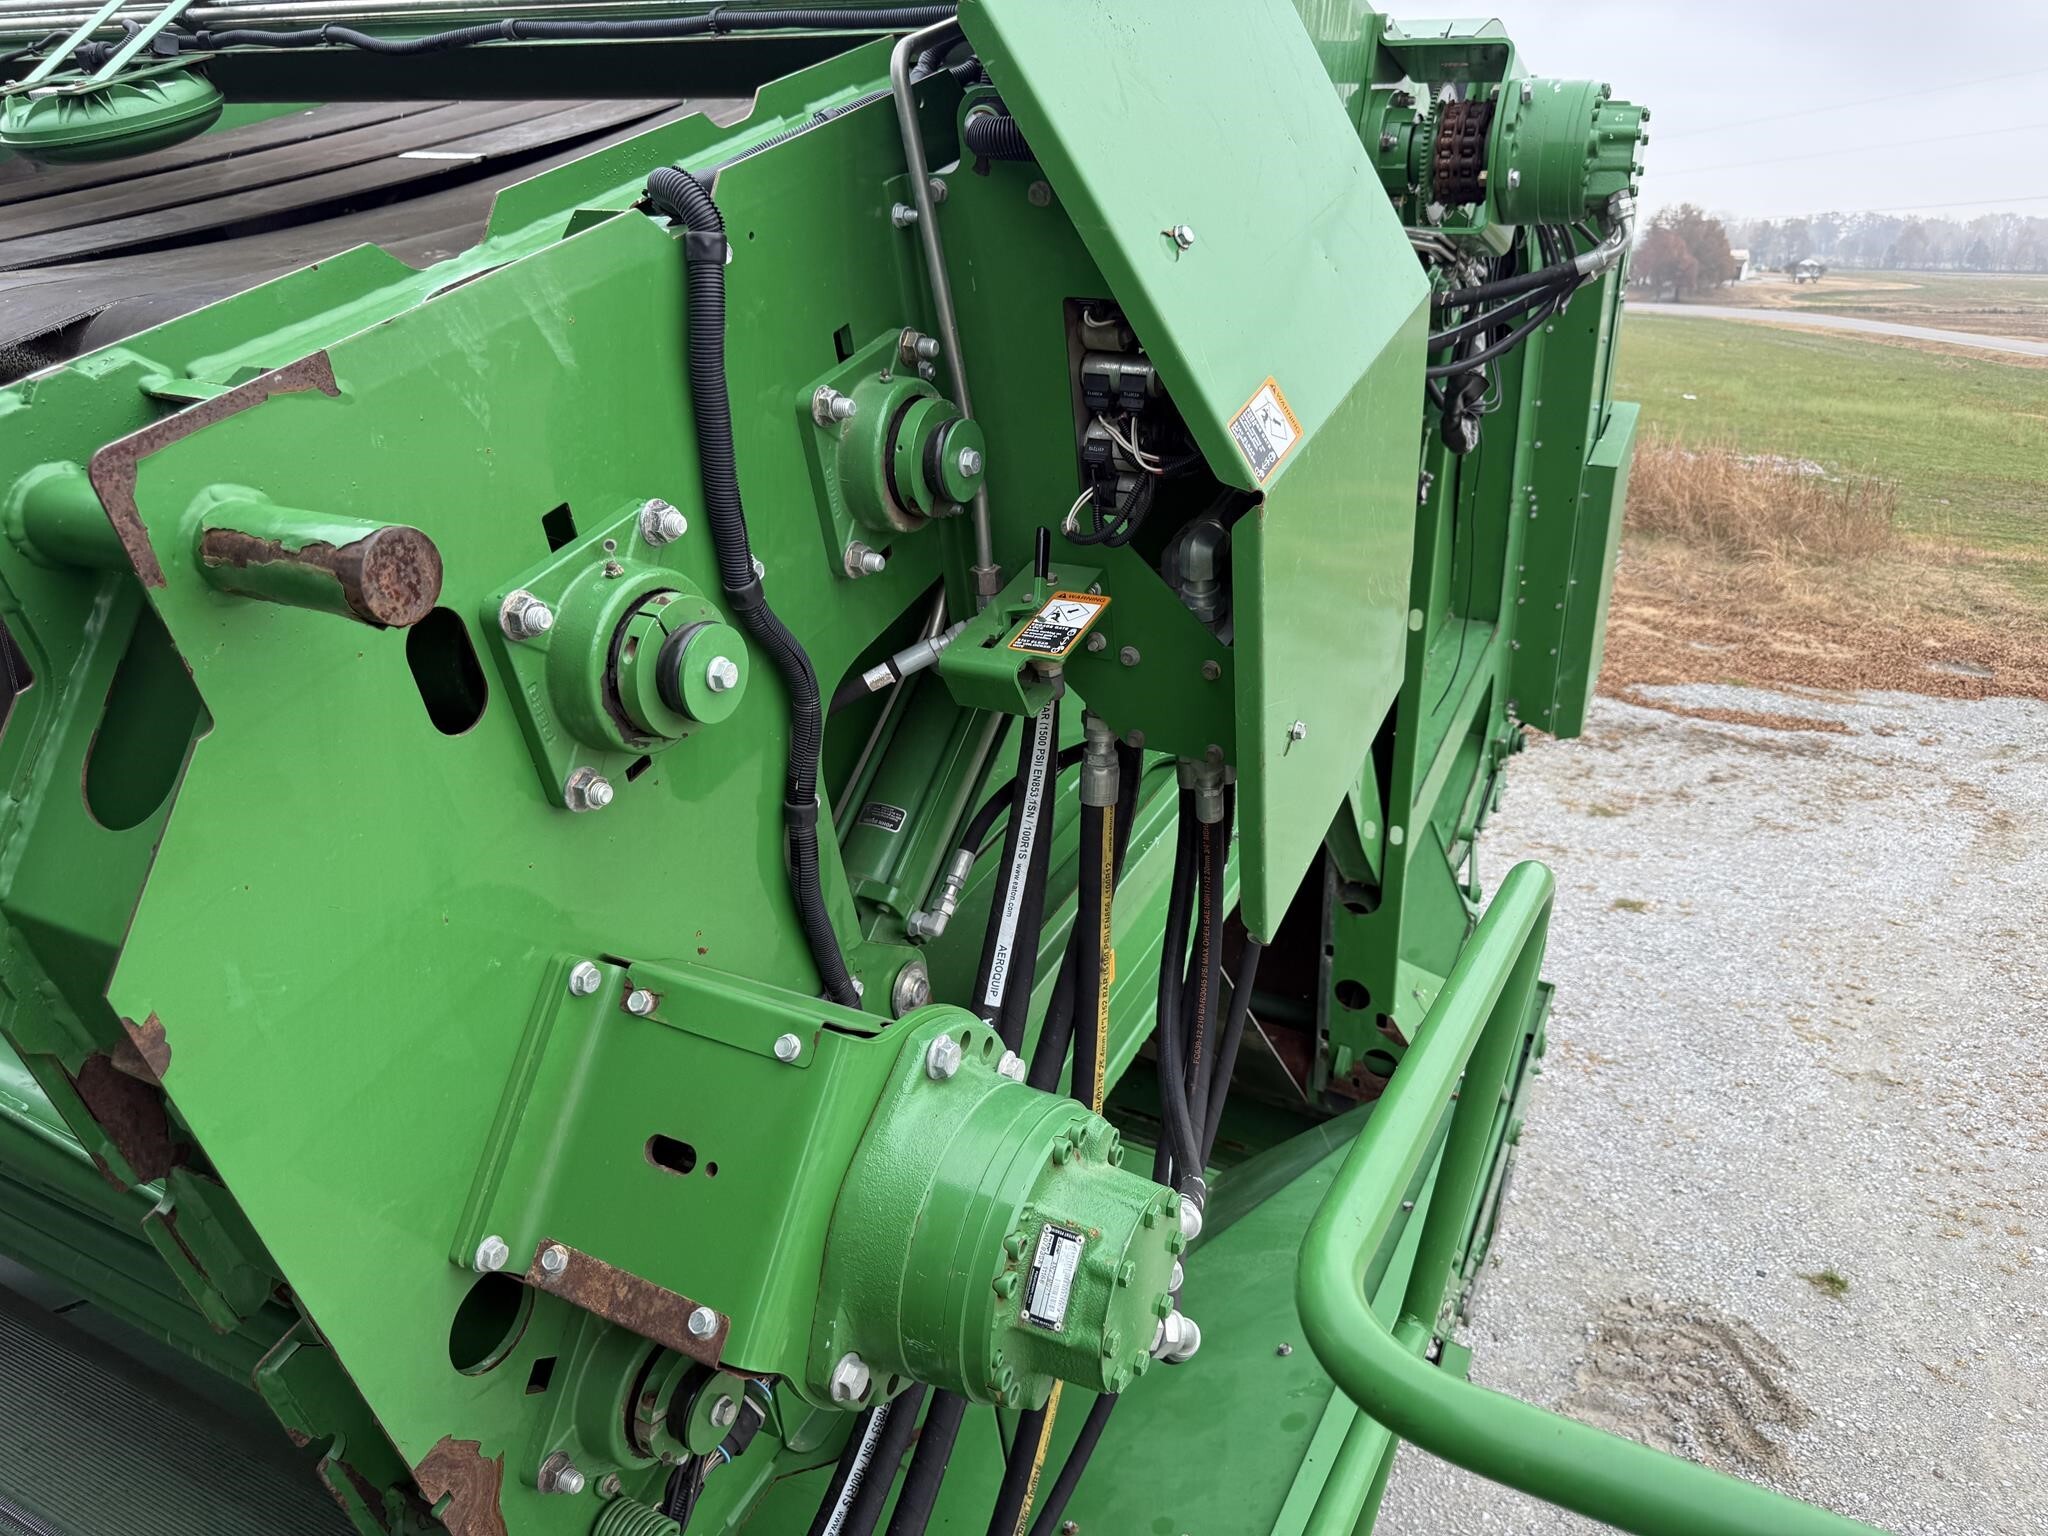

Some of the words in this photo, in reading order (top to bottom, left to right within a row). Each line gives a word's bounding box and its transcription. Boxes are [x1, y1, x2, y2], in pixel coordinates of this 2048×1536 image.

[1277, 392, 1300, 434] WARNING
[1068, 594, 1105, 603] WARNING
[1038, 722, 1050, 746] (1500
[1035, 748, 1046, 767] PSI)
[1029, 769, 1043, 798] EN853
[1027, 799, 1037, 818] 1SN
[1018, 826, 1032, 860] 100R1S
[1006, 863, 1022, 918] www.eaton.com
[1201, 946, 1209, 964] MAX
[990, 945, 1007, 998] AEROQUIP
[862, 1437, 876, 1459] 1SN
[843, 1467, 864, 1509] 100R1S
